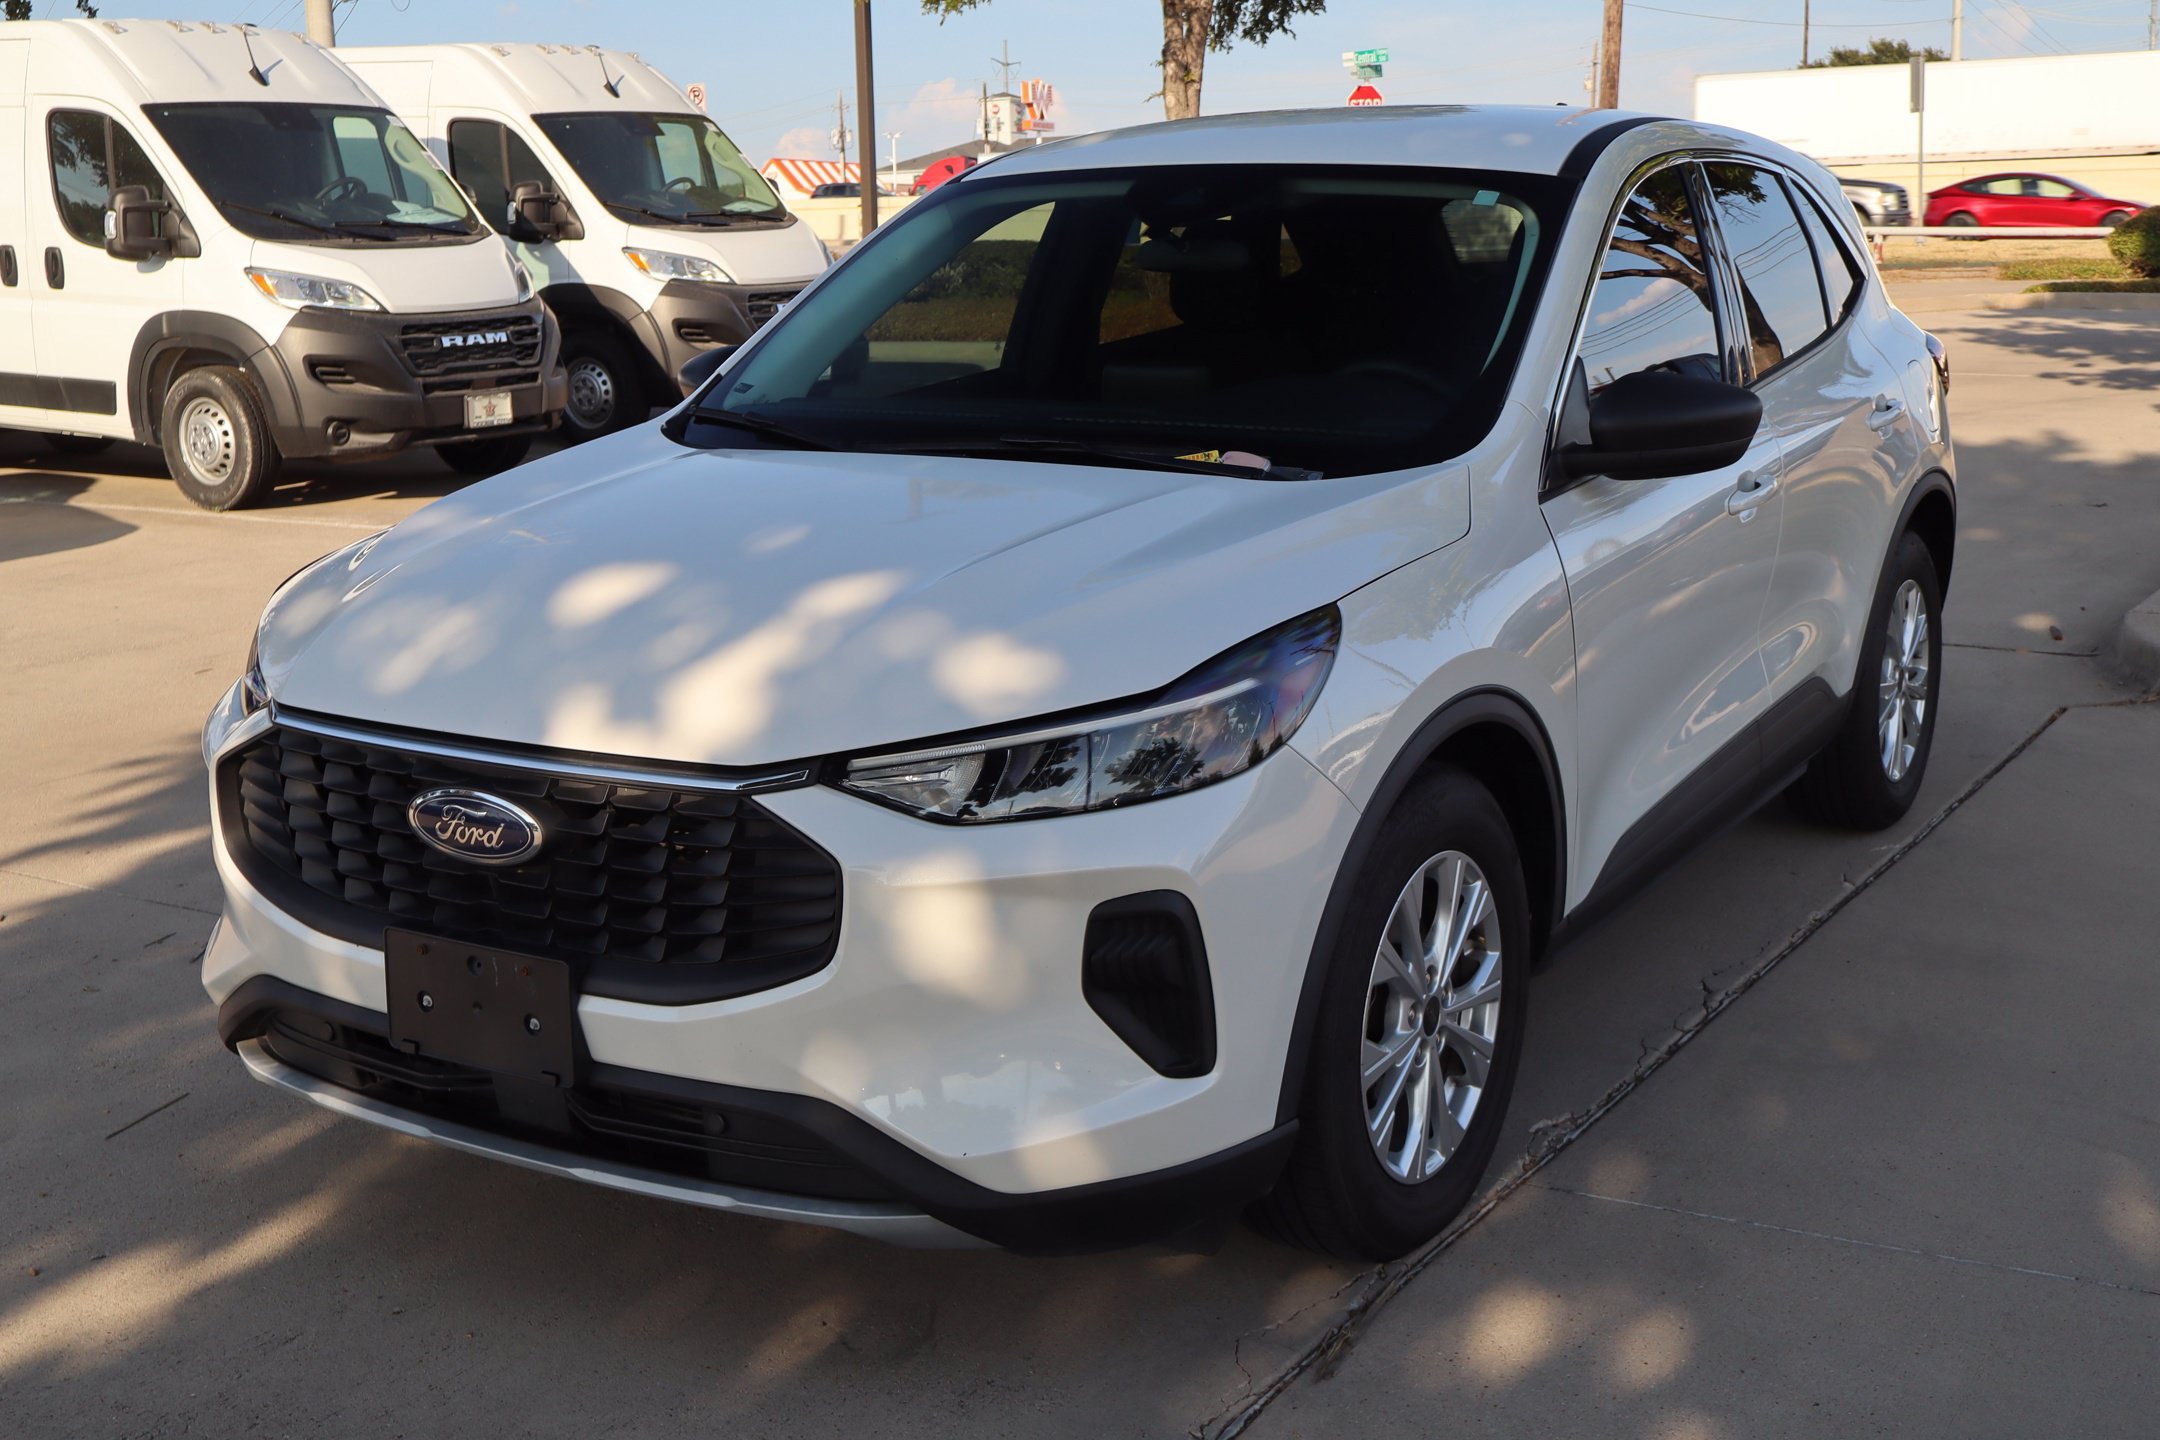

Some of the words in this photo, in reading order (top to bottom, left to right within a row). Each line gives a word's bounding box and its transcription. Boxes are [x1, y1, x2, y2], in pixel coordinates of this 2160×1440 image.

[1354, 50, 1376, 65] Central
[441, 331, 508, 348] RAM
[435, 804, 504, 849] Ford
